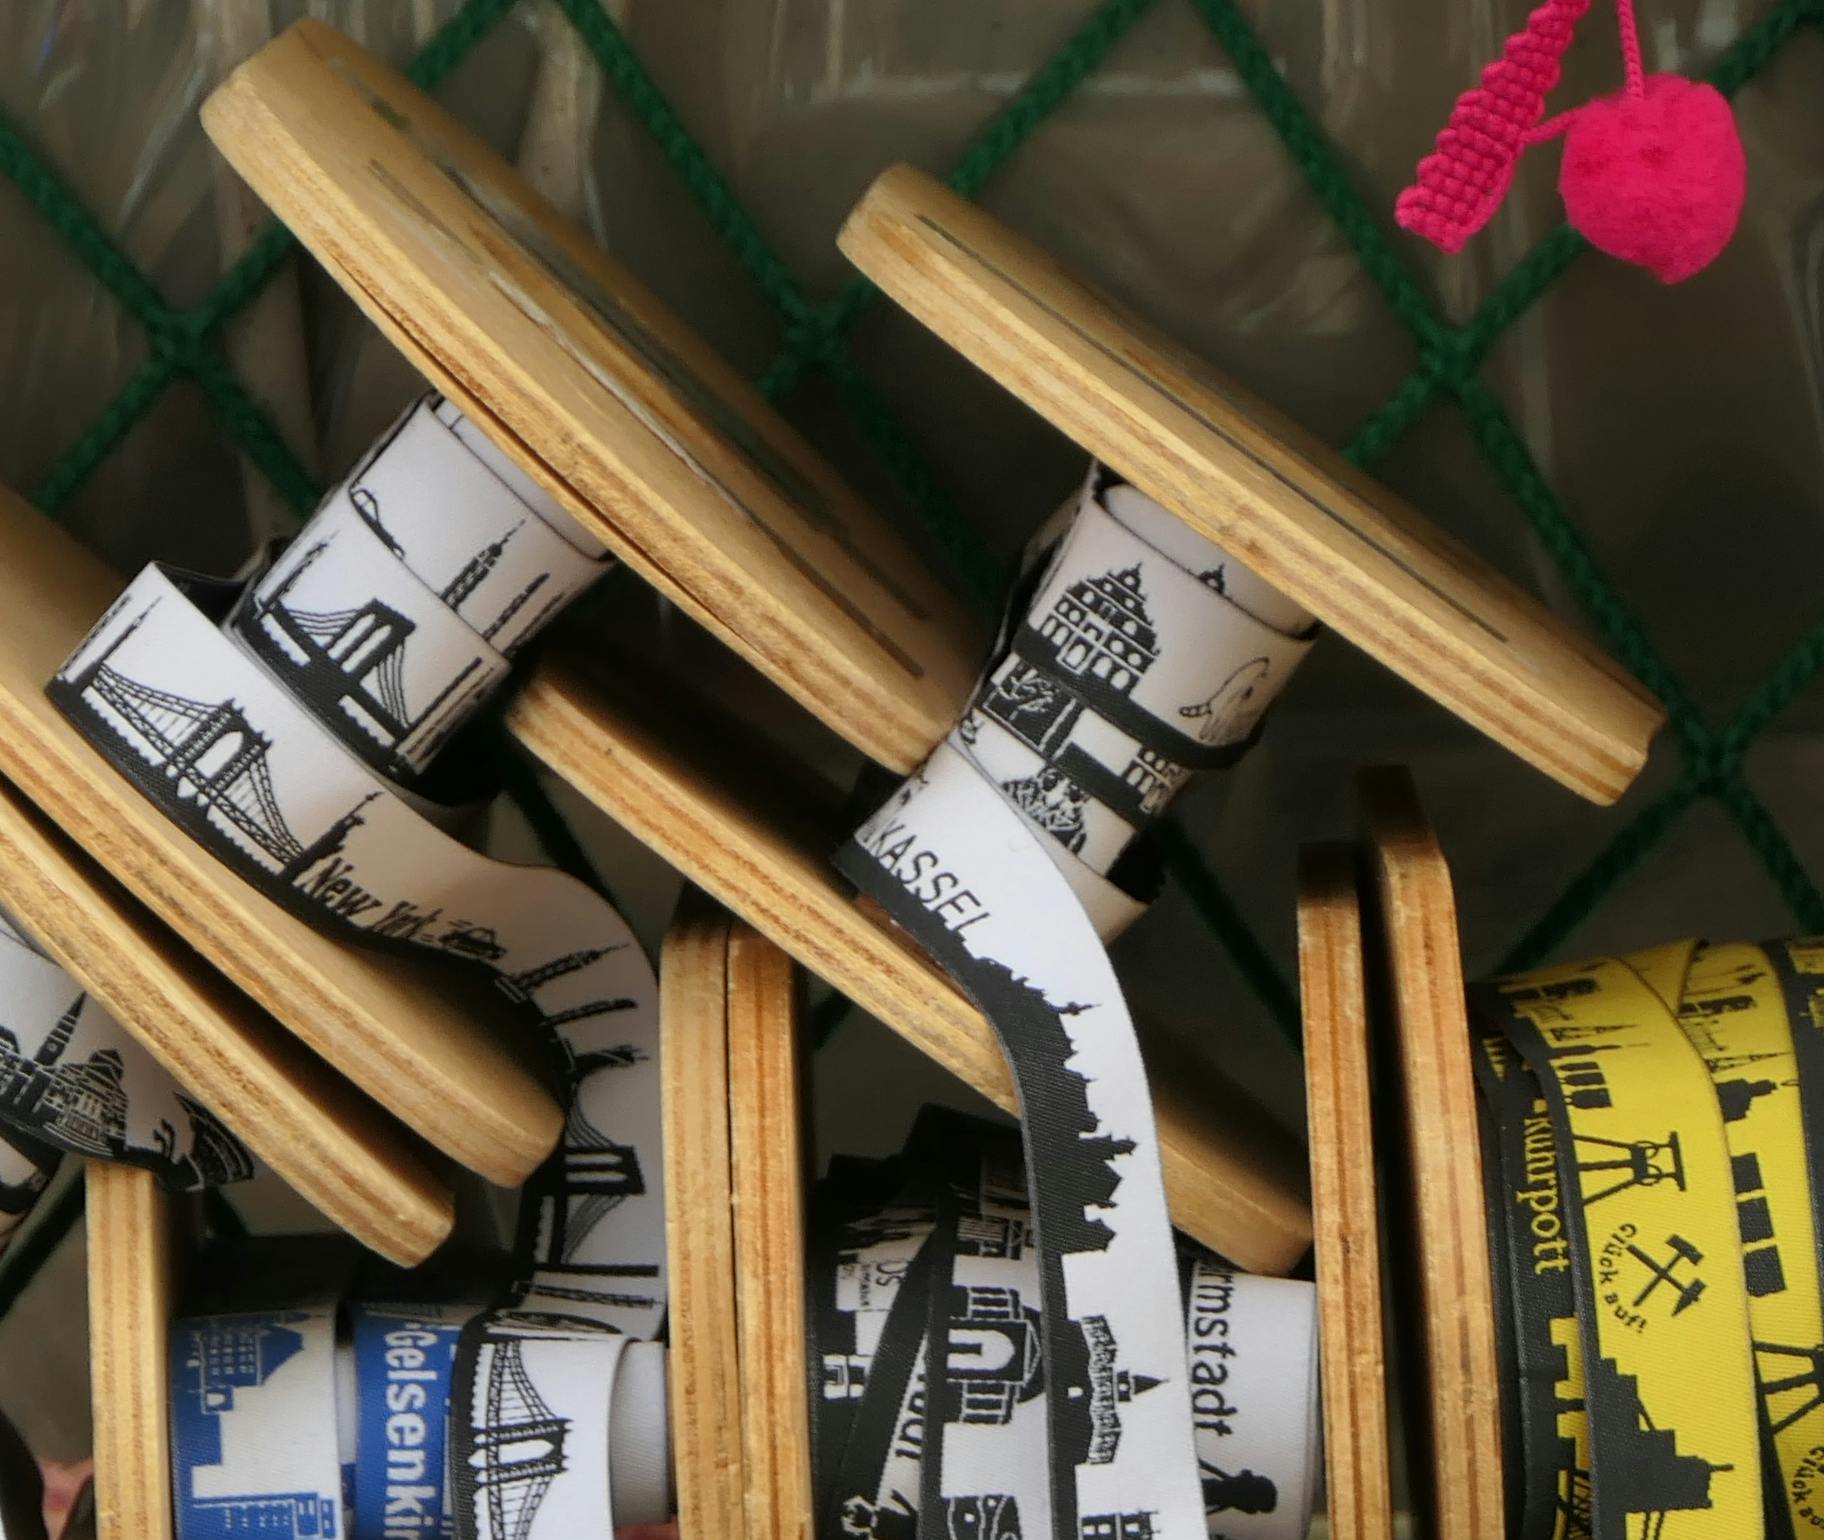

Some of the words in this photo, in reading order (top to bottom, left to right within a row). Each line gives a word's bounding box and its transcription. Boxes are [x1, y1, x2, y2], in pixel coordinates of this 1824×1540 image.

[298, 856, 384, 917] New
[868, 817, 991, 934] KASSEL
[1598, 1222, 1637, 1284] Glück
[1604, 1291, 1649, 1334] auf!
[1191, 1268, 1239, 1437] rmstadt
